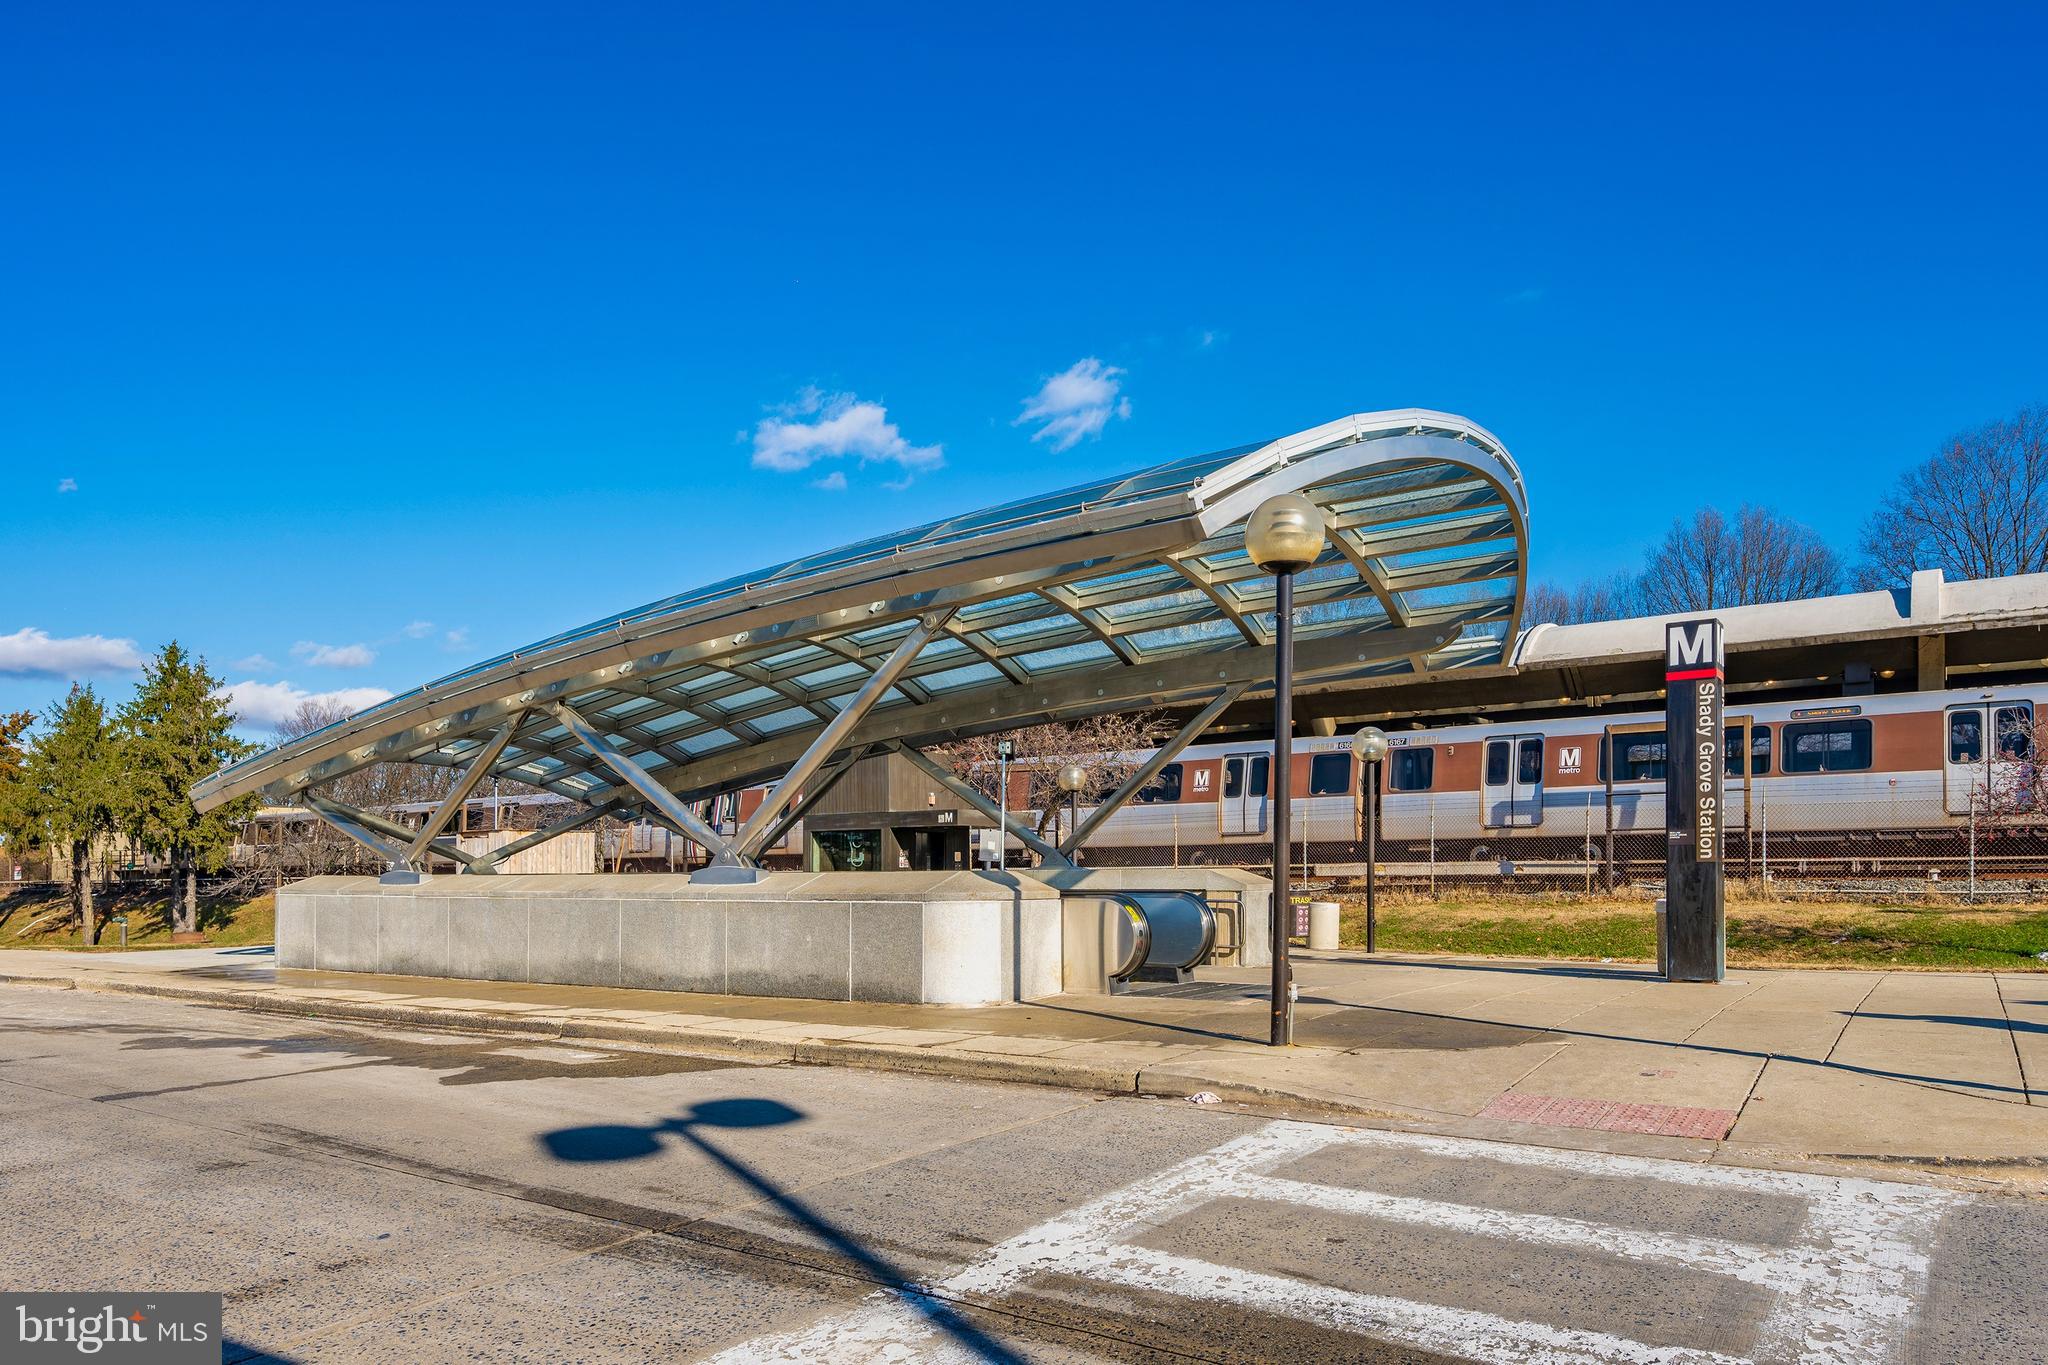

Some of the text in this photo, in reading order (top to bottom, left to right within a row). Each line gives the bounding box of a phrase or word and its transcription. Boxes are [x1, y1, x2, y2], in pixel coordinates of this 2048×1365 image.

[1669, 623, 1713, 667] M
[1389, 738, 1405, 746] 6167
[1561, 748, 1580, 766] M
[1195, 770, 1209, 786] M
[1696, 683, 1716, 859] Shady Grove Station
[944, 812, 953, 823] M
